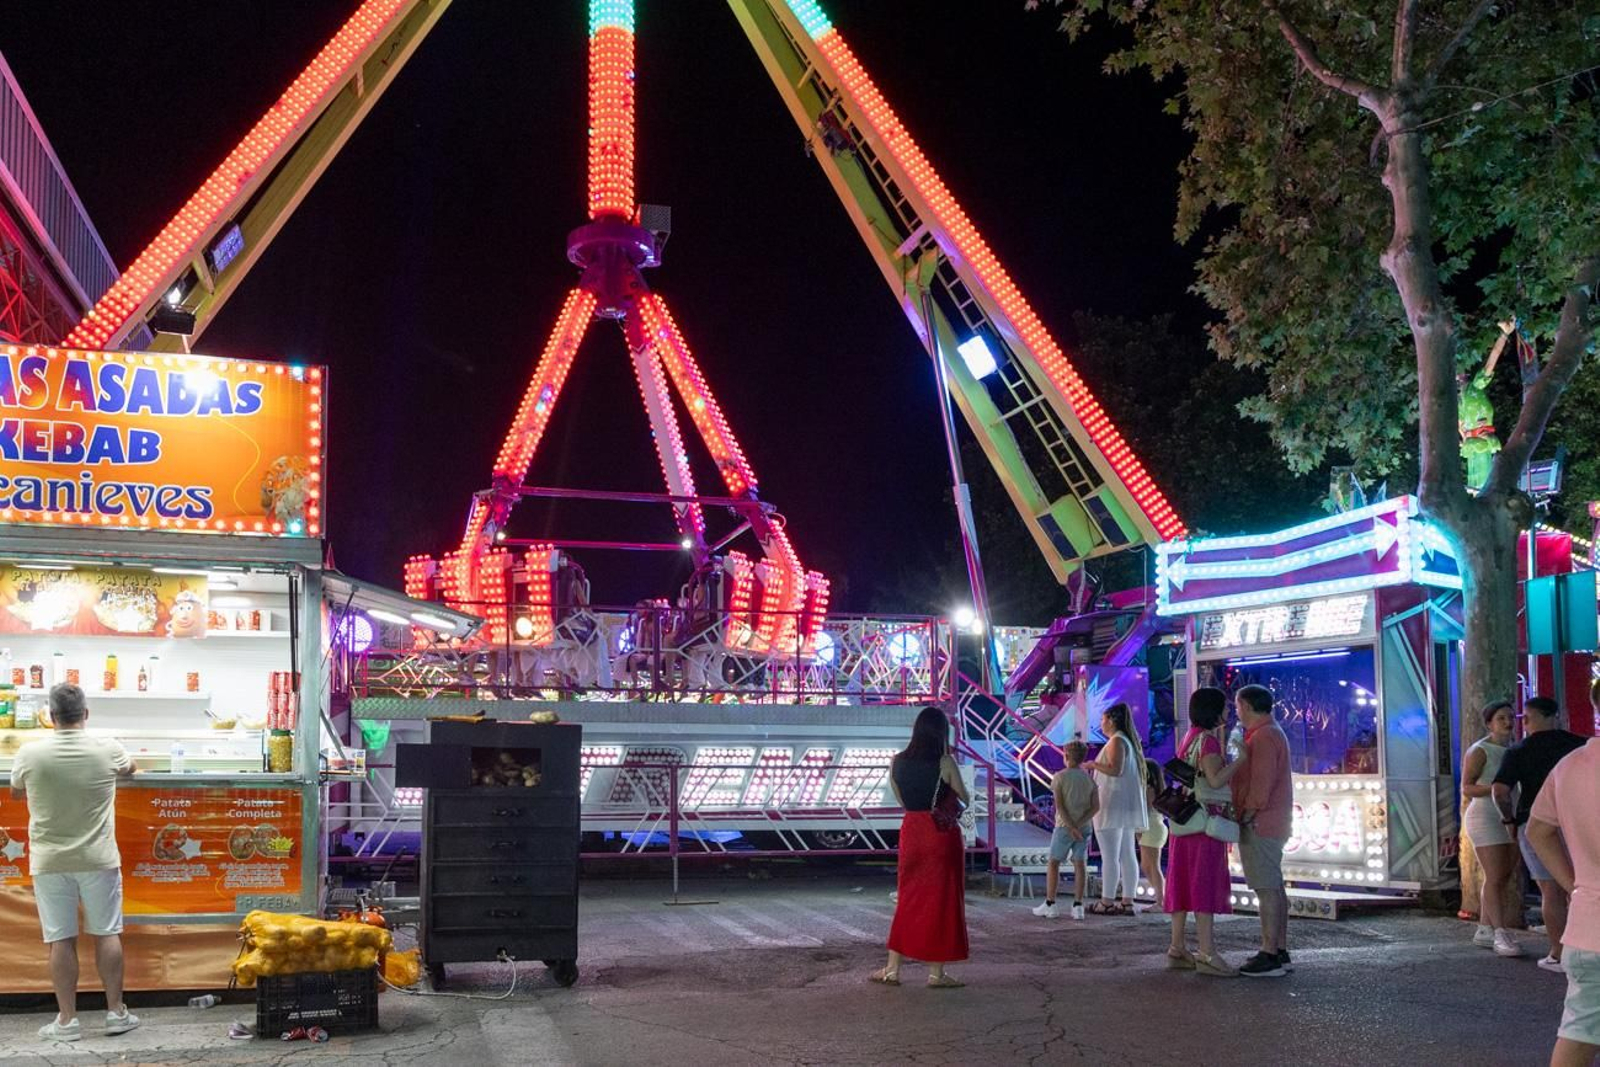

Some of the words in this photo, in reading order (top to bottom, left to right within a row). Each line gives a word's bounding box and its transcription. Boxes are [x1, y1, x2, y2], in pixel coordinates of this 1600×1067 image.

[57, 358, 264, 416] ASADAS
[95, 573, 162, 587] PATATA
[1201, 595, 1368, 649] EXTREME
[153, 798, 192, 808] Patata
[236, 798, 275, 808] Patata
[158, 808, 187, 818] Atún
[228, 808, 282, 820] Completa
